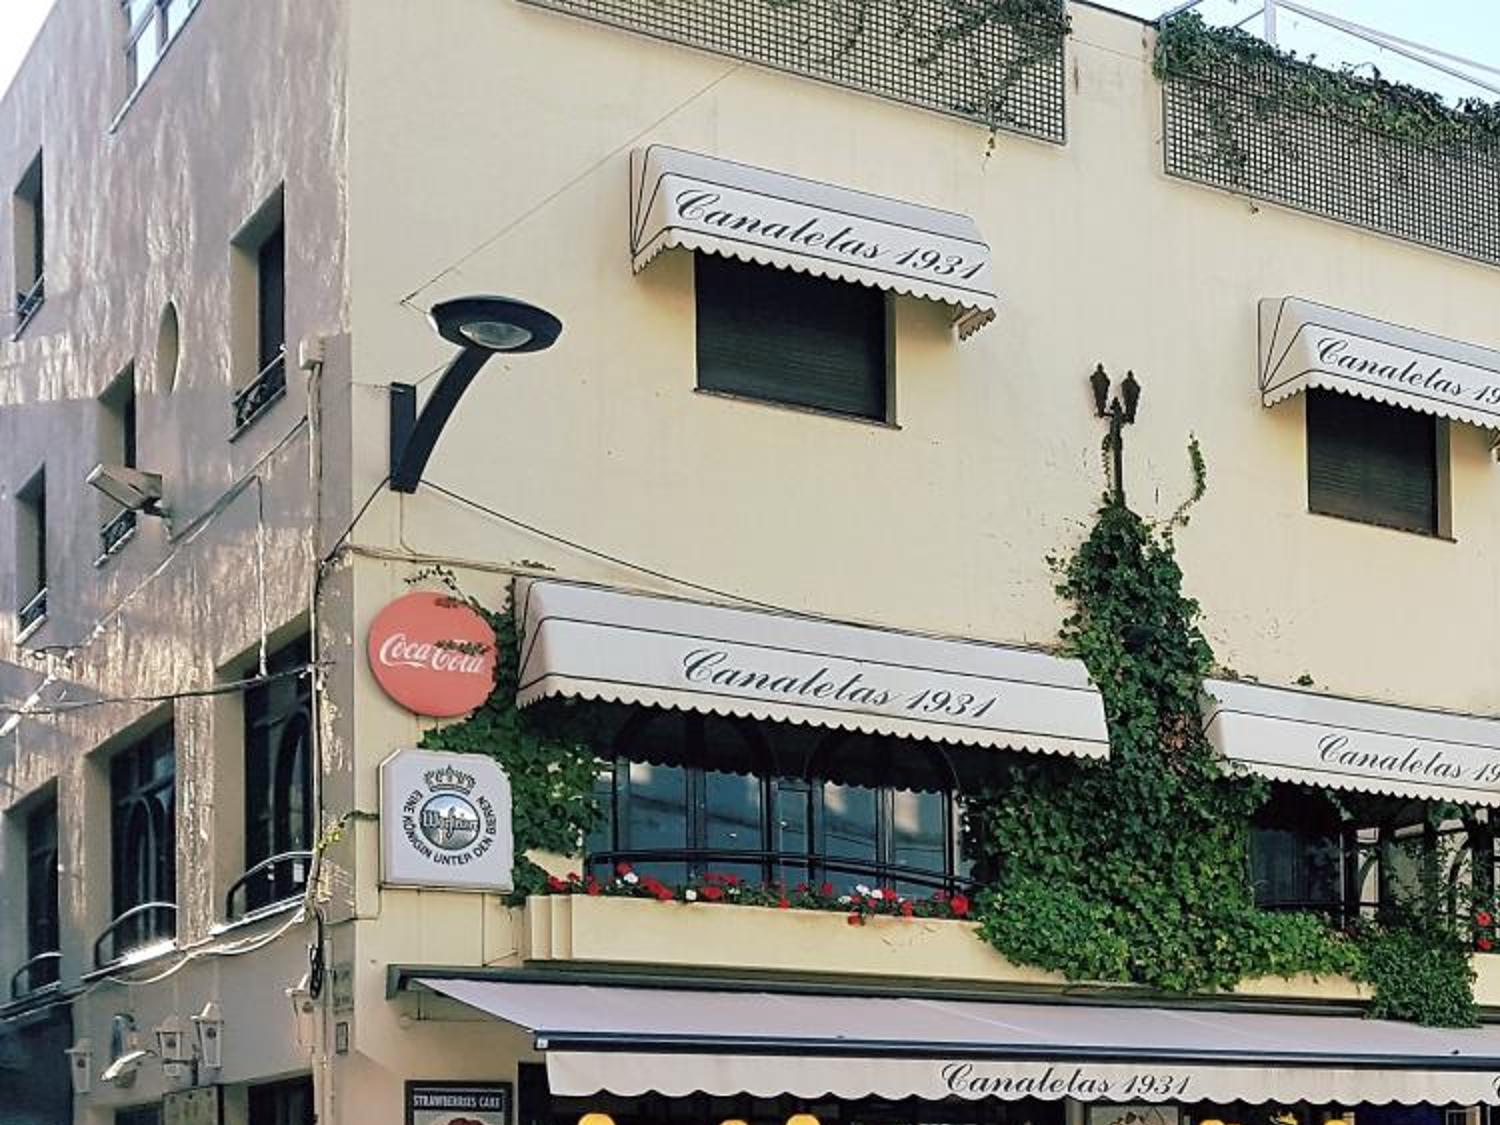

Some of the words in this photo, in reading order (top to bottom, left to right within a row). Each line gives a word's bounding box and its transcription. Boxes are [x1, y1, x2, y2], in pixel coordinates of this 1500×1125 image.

[676, 189, 880, 259] Canaletas
[896, 247, 985, 280] 1931
[1317, 337, 1464, 397] Canaletas
[683, 649, 892, 707] Canaletas
[905, 689, 998, 718] 1931
[1317, 733, 1462, 779] Canaletas
[433, 854, 472, 865] UNTER
[473, 837, 493, 858] DEN
[941, 1063, 1113, 1093] Canaletas
[1123, 1074, 1190, 1095] 1931
